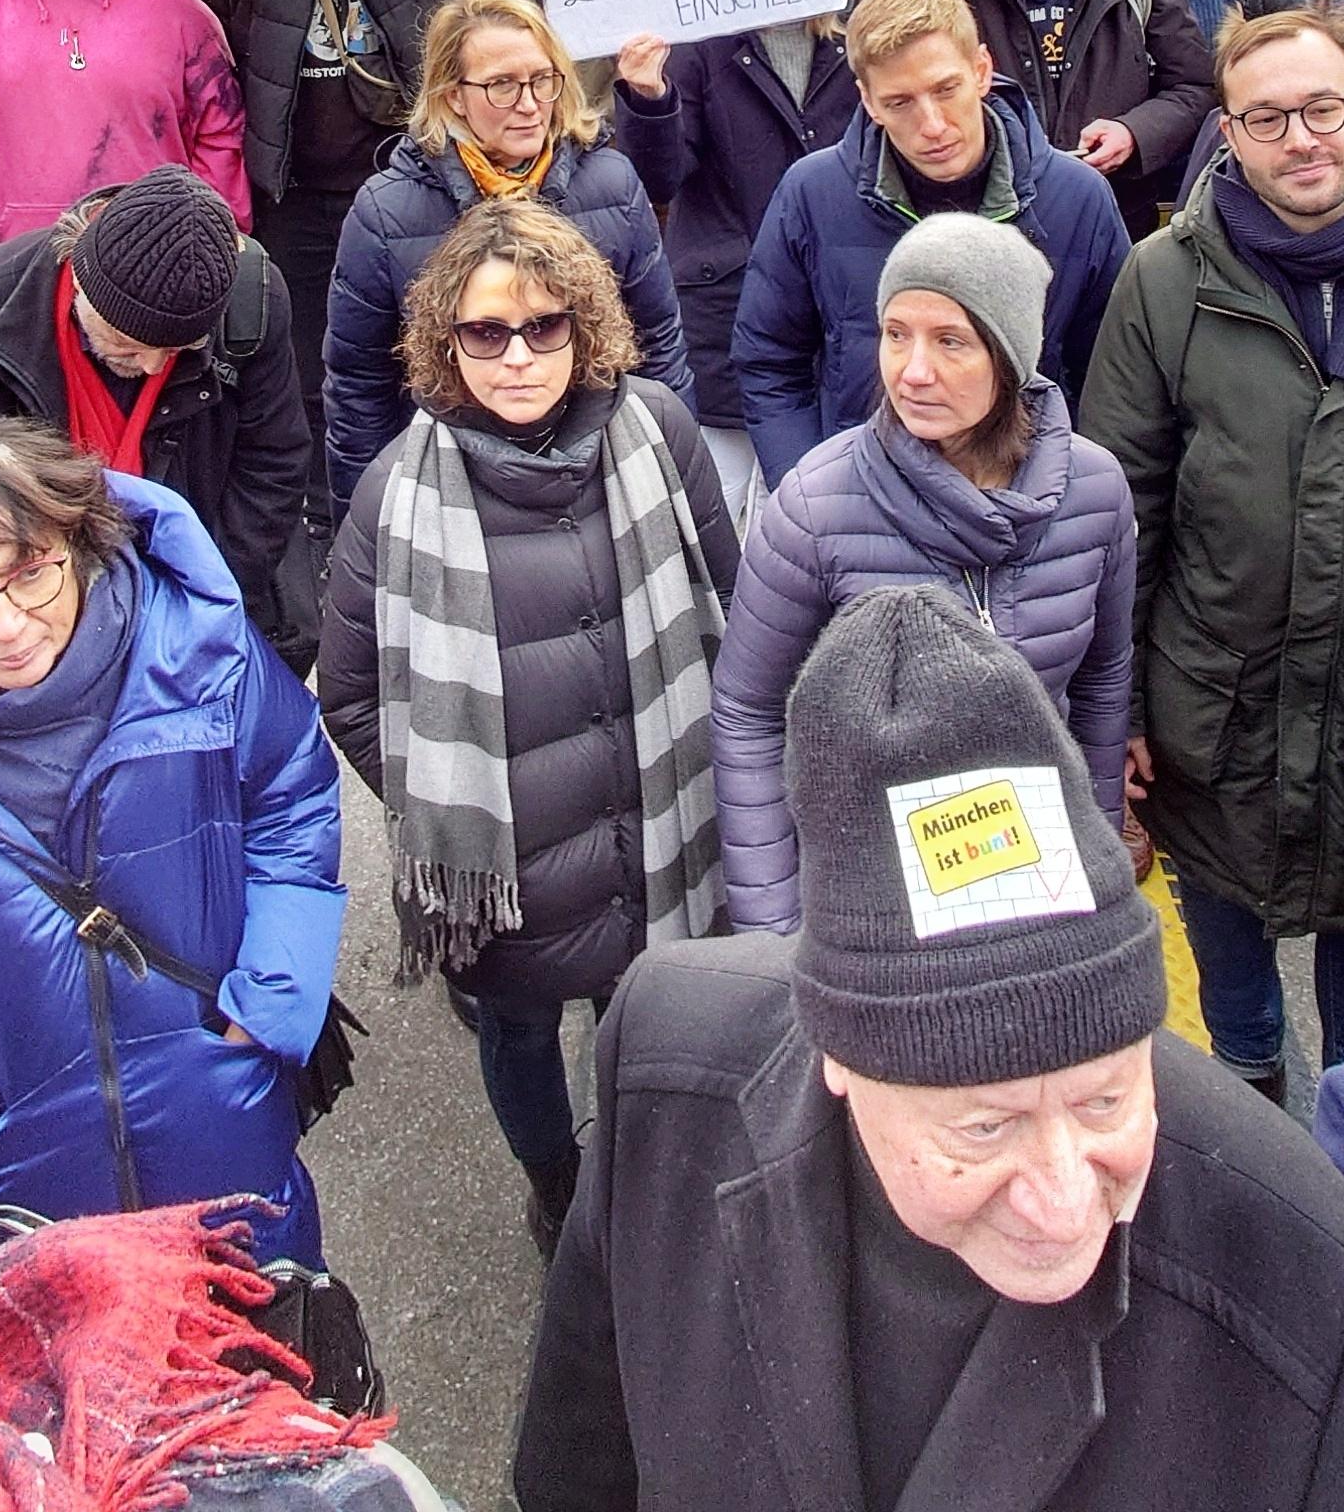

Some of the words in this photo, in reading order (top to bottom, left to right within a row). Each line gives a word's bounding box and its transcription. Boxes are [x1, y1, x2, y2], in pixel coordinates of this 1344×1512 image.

[922, 797, 1013, 842] München
[935, 848, 963, 872] ist
[965, 826, 1021, 862] bunt!
